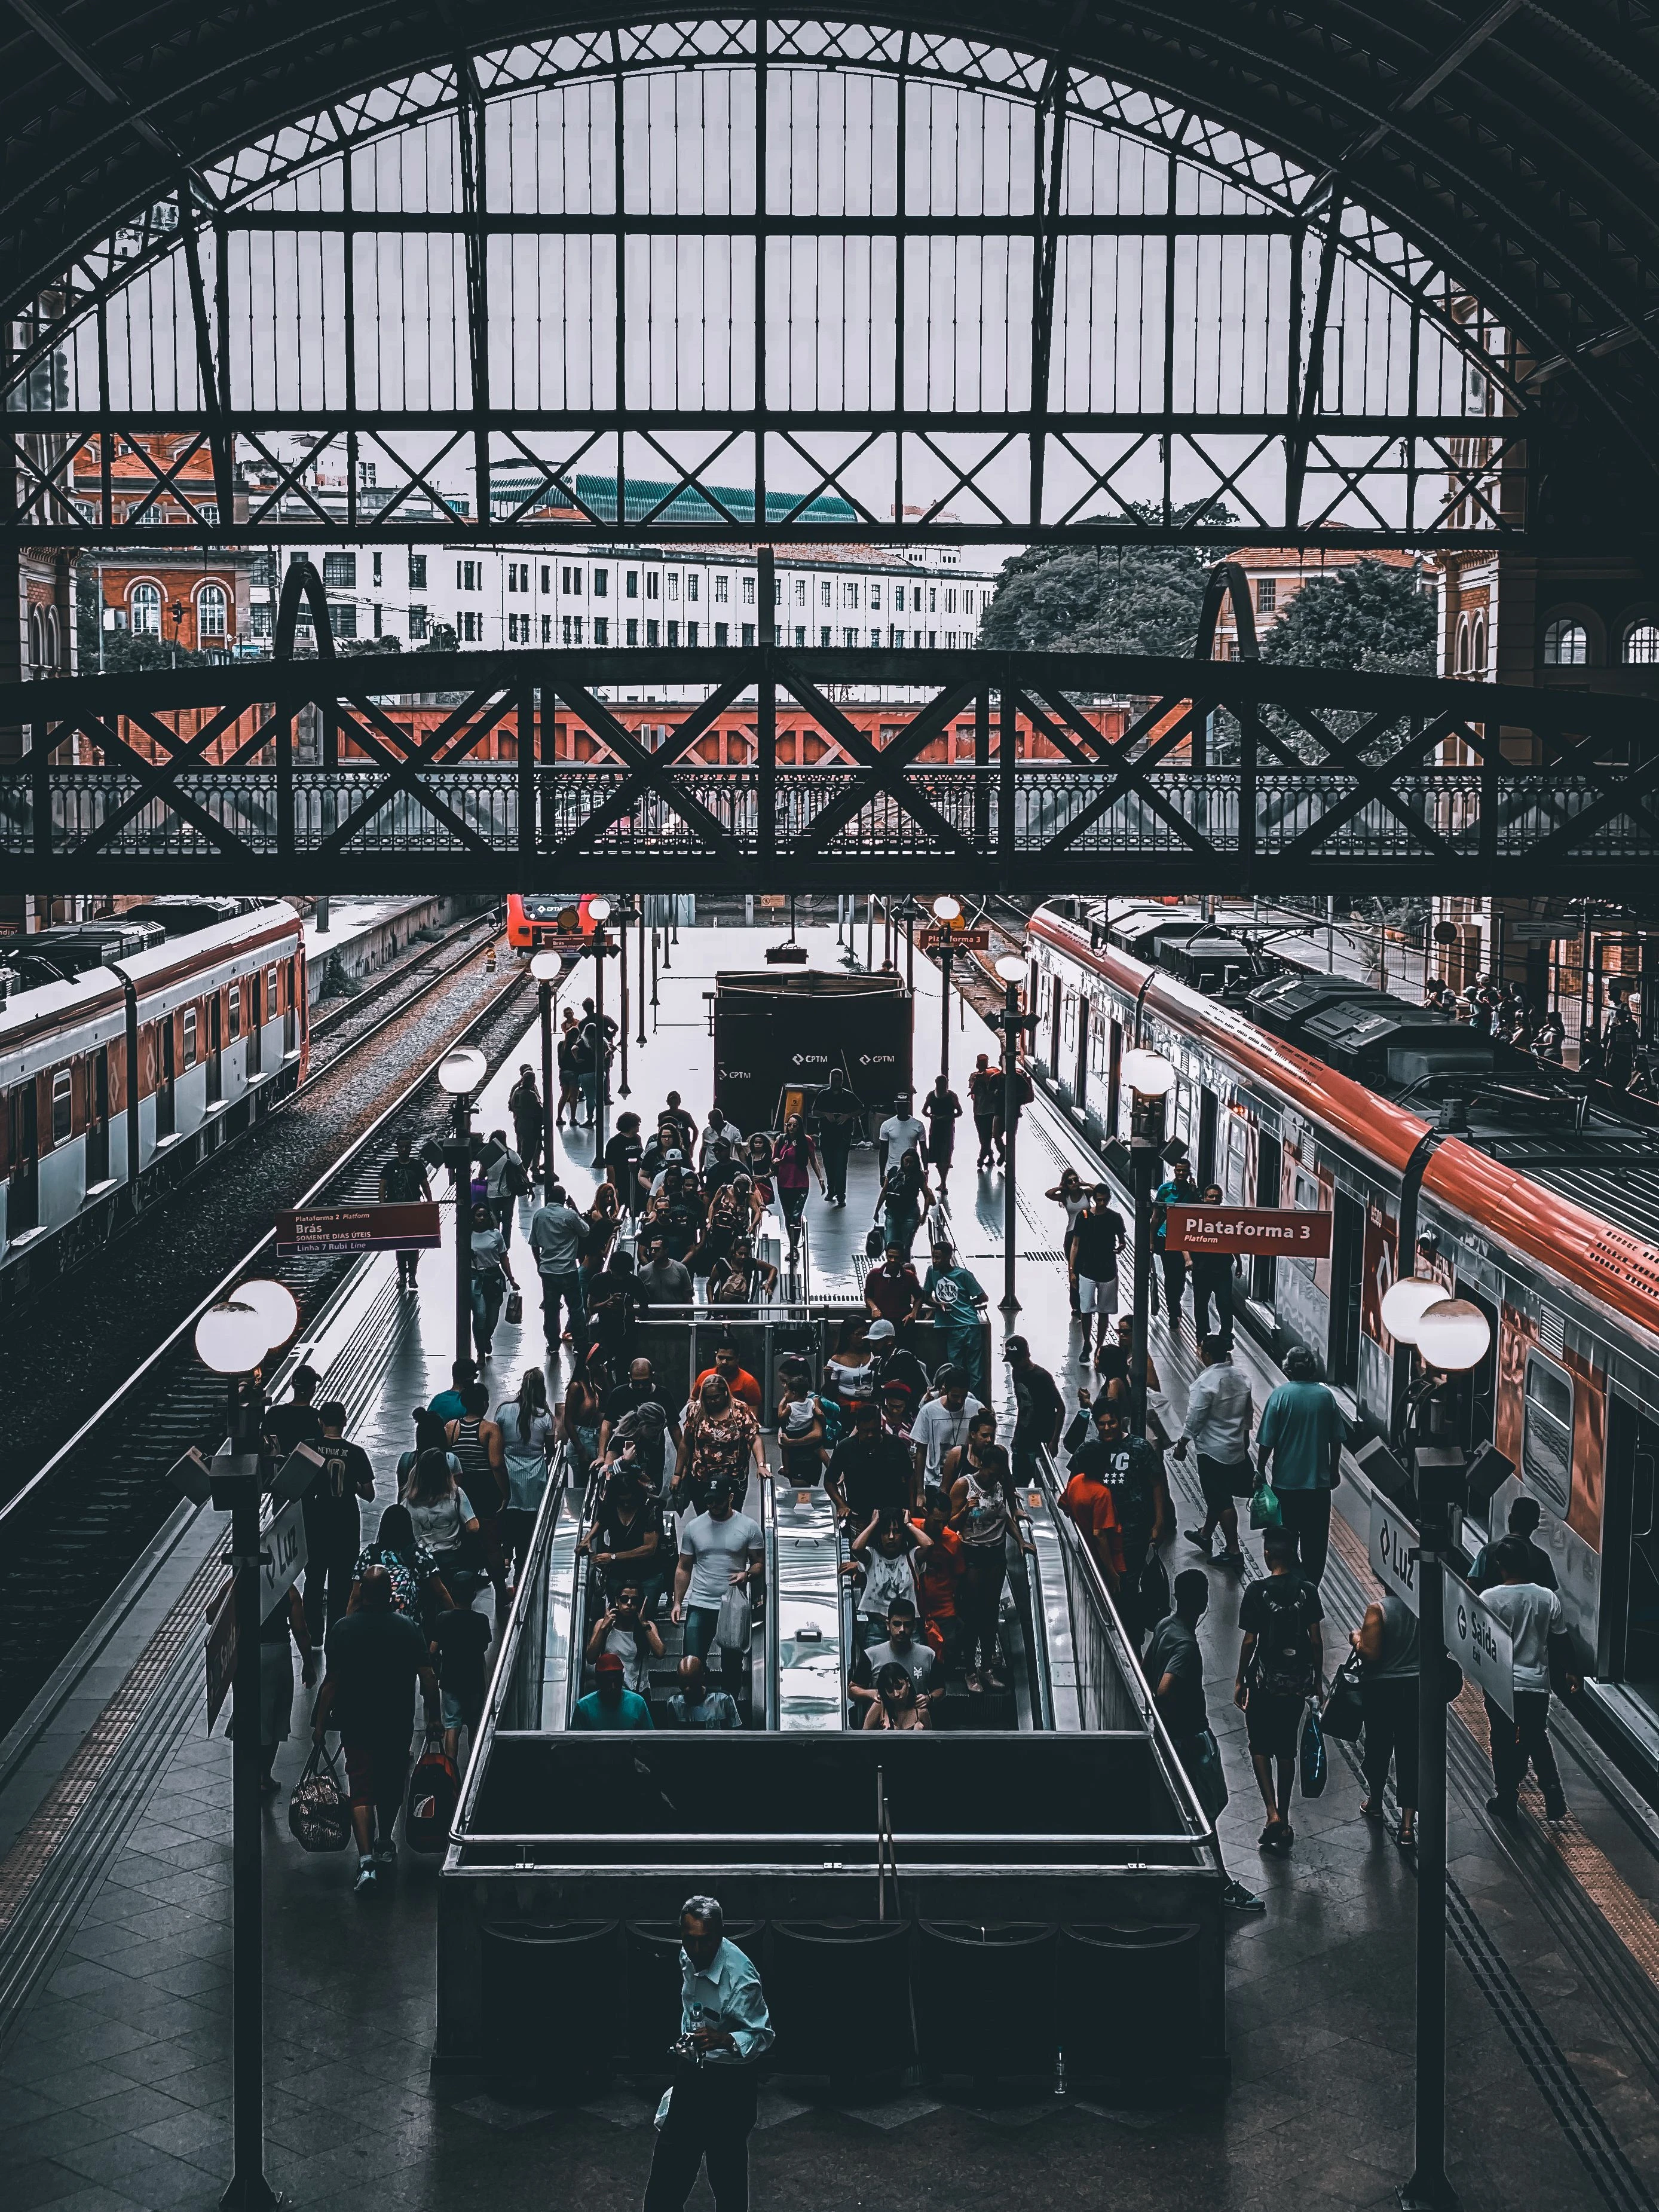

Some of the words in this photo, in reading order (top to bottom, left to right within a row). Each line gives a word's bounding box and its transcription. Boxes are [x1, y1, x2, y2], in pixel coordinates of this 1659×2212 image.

[296, 1224, 322, 1234] Brás
[1184, 1235, 1218, 1243] Platform
[1186, 1219, 1293, 1238] Plataforma
[1300, 1226, 1310, 1239] 3
[317, 1446, 339, 1456] NEYMAR
[277, 1525, 298, 1576] Luz
[1392, 1530, 1413, 1592] Luz
[1471, 1611, 1497, 1663] Saída
